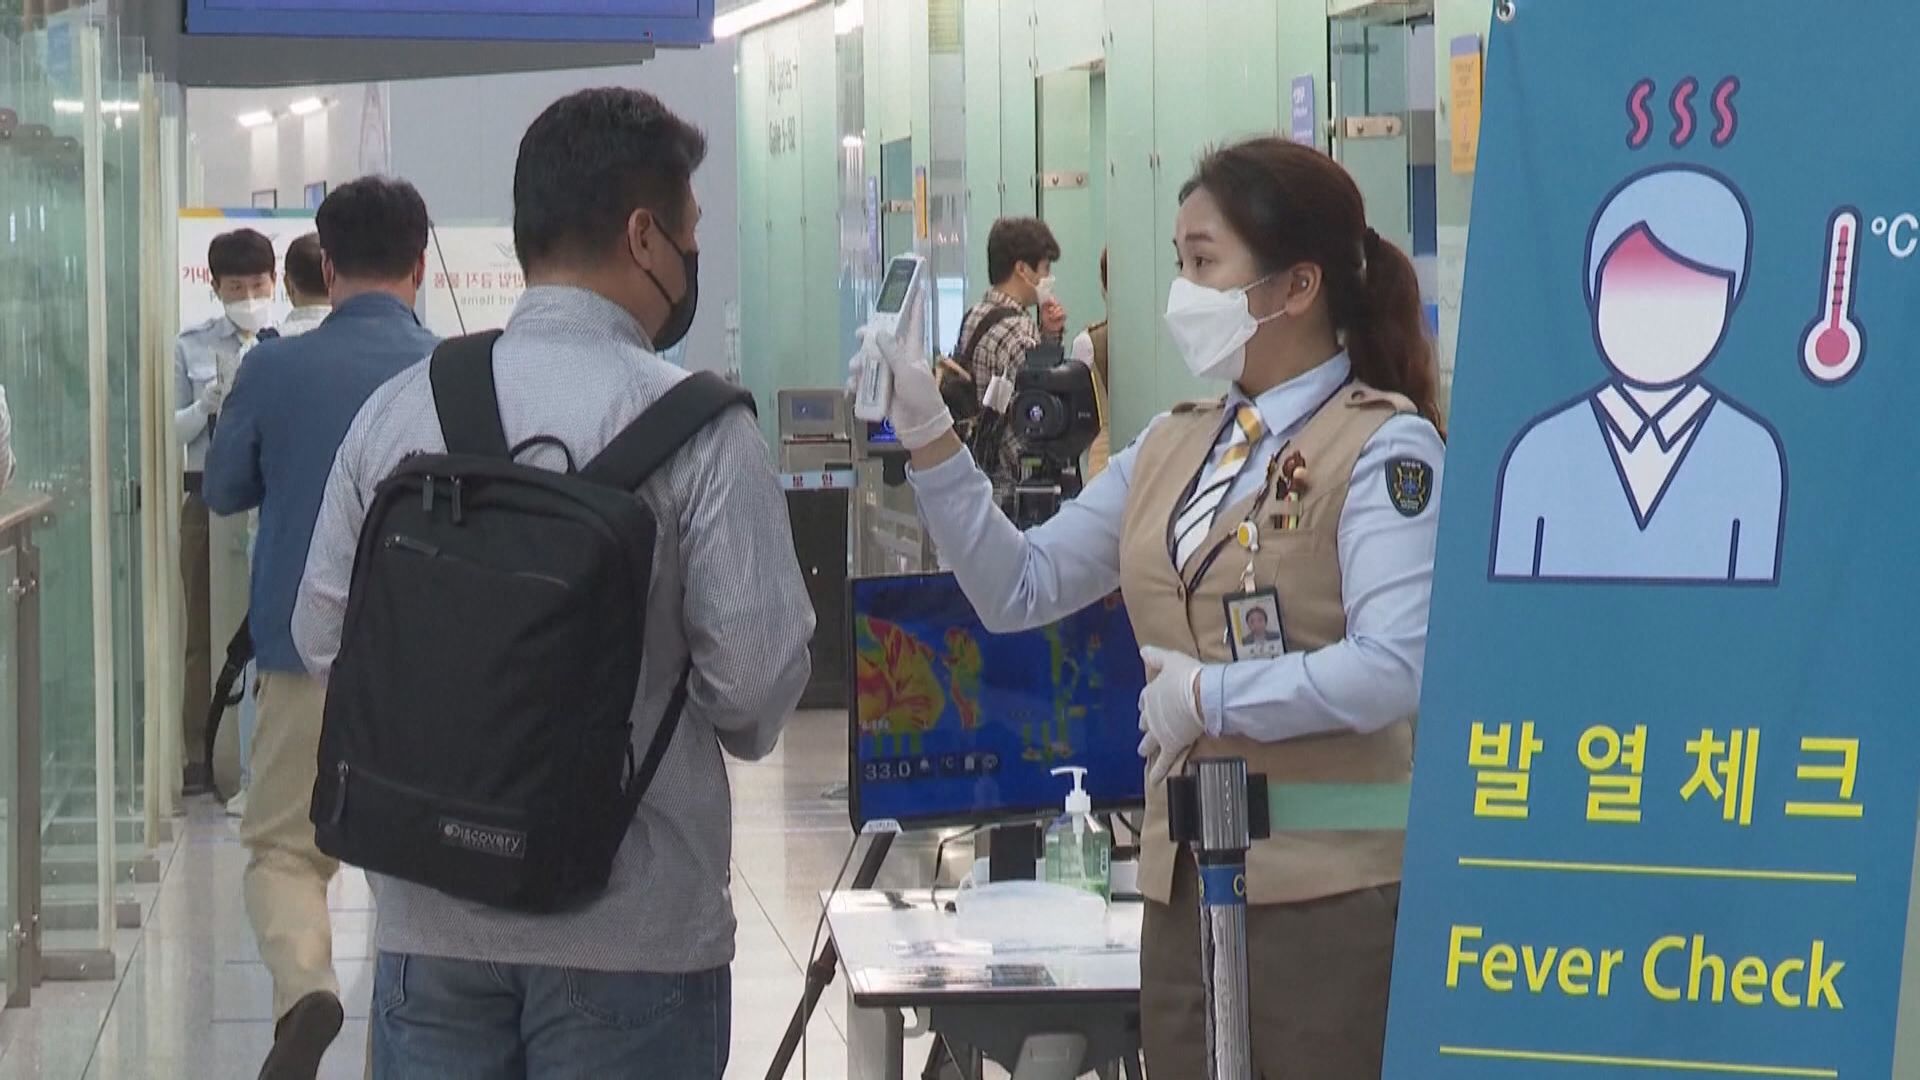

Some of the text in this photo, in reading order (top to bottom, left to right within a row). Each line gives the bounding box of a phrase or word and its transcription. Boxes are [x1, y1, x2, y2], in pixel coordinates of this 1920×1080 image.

[865, 761, 911, 781] 33.0
[1446, 924, 1846, 1010] Fever Check
